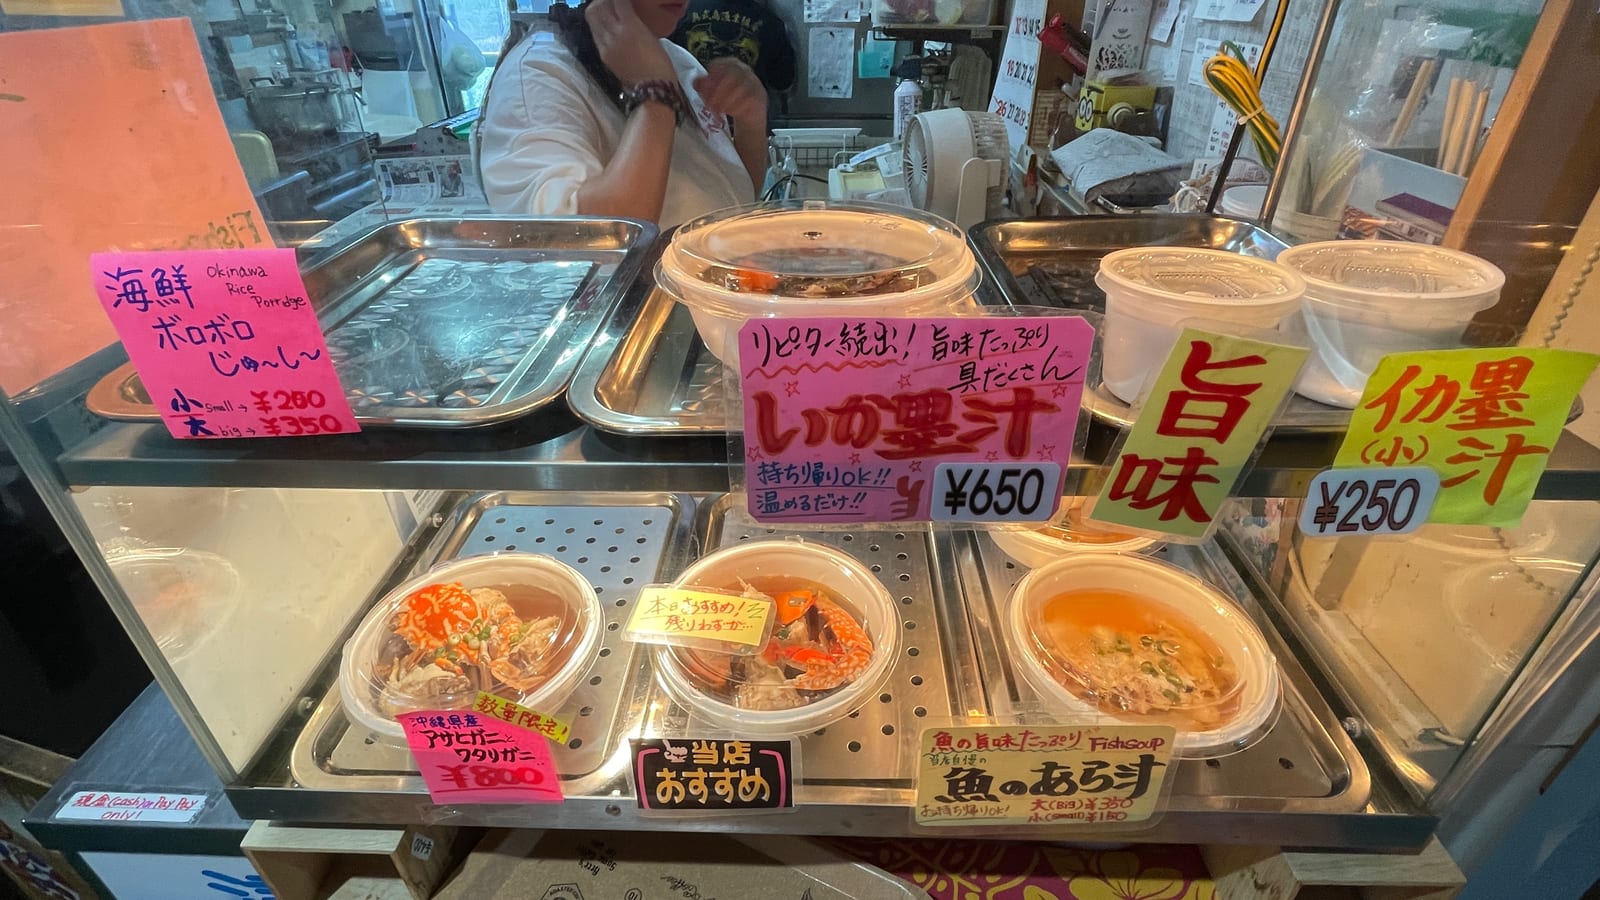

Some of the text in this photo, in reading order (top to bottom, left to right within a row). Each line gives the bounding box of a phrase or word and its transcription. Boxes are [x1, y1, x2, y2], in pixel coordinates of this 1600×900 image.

[103, 264, 195, 312] 海鮮
[206, 262, 268, 278] Okinawa
[225, 282, 256, 295] Rice
[152, 312, 255, 350] ボロボロ
[932, 324, 1049, 361] 旨味たっぷり
[949, 347, 1082, 393] 具だくさん
[171, 388, 204, 412] 小
[219, 424, 242, 437] big
[259, 414, 343, 436] ¥350
[752, 386, 1060, 460] いか墨汁
[1107, 340, 1268, 523] 旨味
[944, 468, 1046, 516] ¥650
[1314, 478, 1421, 533] ¥250
[410, 713, 484, 729] 沖縄県産
[477, 694, 569, 741] 数量限定!
[419, 728, 516, 748] アサヒガニと
[453, 747, 536, 763] ワタリガニ
[691, 739, 751, 765] 当店
[931, 729, 1082, 752] 魚の旨味たっぷり
[436, 765, 545, 788] ¥800
[655, 767, 771, 805] おすすめ
[934, 753, 1166, 803] 魚のあら汁
